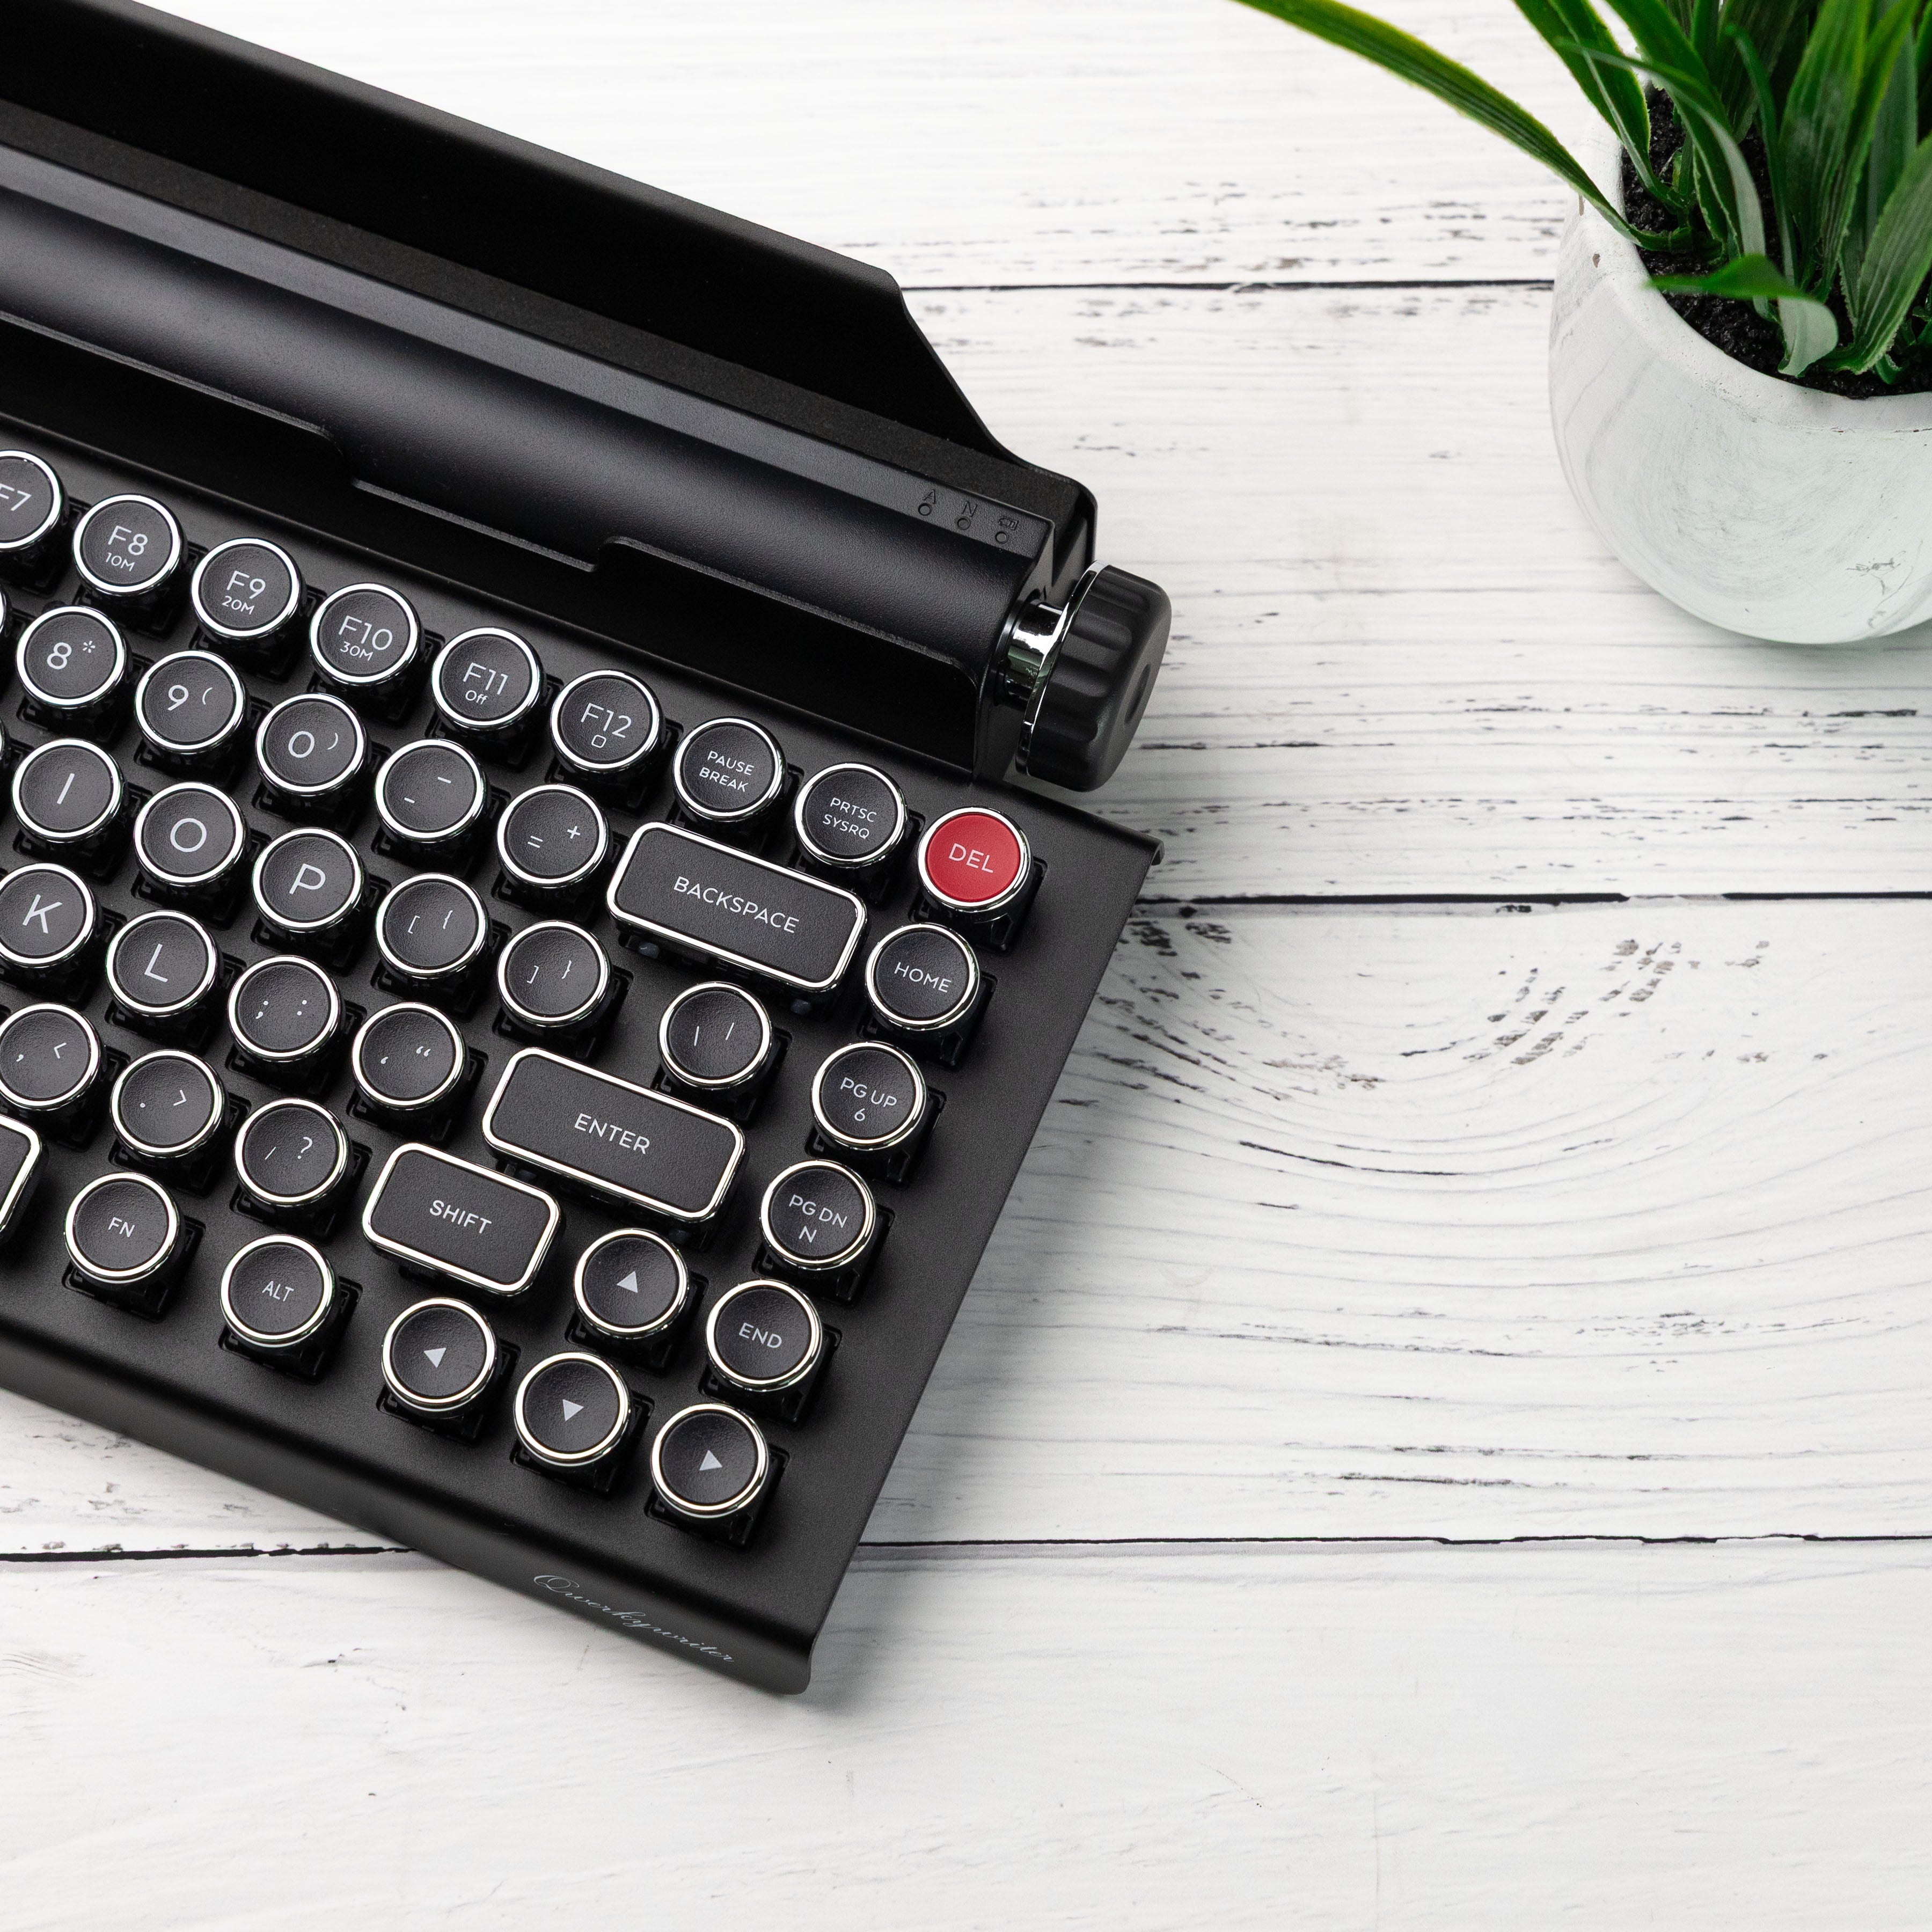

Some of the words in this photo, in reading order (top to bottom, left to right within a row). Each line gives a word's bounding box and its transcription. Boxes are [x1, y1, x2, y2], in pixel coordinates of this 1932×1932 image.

[922, 488, 937, 505] A
[961, 500, 978, 518] N
[108, 525, 148, 555] F8
[106, 552, 135, 572] 10M
[226, 570, 266, 599] F9
[222, 595, 255, 615] 20M
[339, 615, 393, 650] F10
[47, 642, 72, 670] 8
[340, 641, 374, 661] 30M
[463, 662, 508, 695] F11
[167, 684, 189, 711] 9
[465, 690, 488, 705] Off
[581, 702, 632, 738] F12
[707, 750, 755, 775] PAUSE
[699, 767, 749, 792] BREAK
[830, 797, 877, 823] PRTSC
[823, 814, 870, 839] SYSRQ
[948, 843, 993, 873] DEL
[289, 863, 326, 895] P
[22, 894, 63, 934] K
[674, 876, 800, 933] BACKSPACE
[144, 943, 168, 983] L
[894, 962, 952, 993] HOME
[840, 1077, 868, 1098] PG
[870, 1090, 897, 1108] UP
[854, 1108, 866, 1122] 6
[574, 1113, 650, 1154] ENTER
[429, 1199, 492, 1234] SHIFT
[789, 1194, 816, 1216] PG
[818, 1207, 847, 1228] DN
[108, 1217, 135, 1238] FN
[799, 1226, 817, 1243] N
[262, 1280, 294, 1302] ALT
[738, 1322, 782, 1349] END
